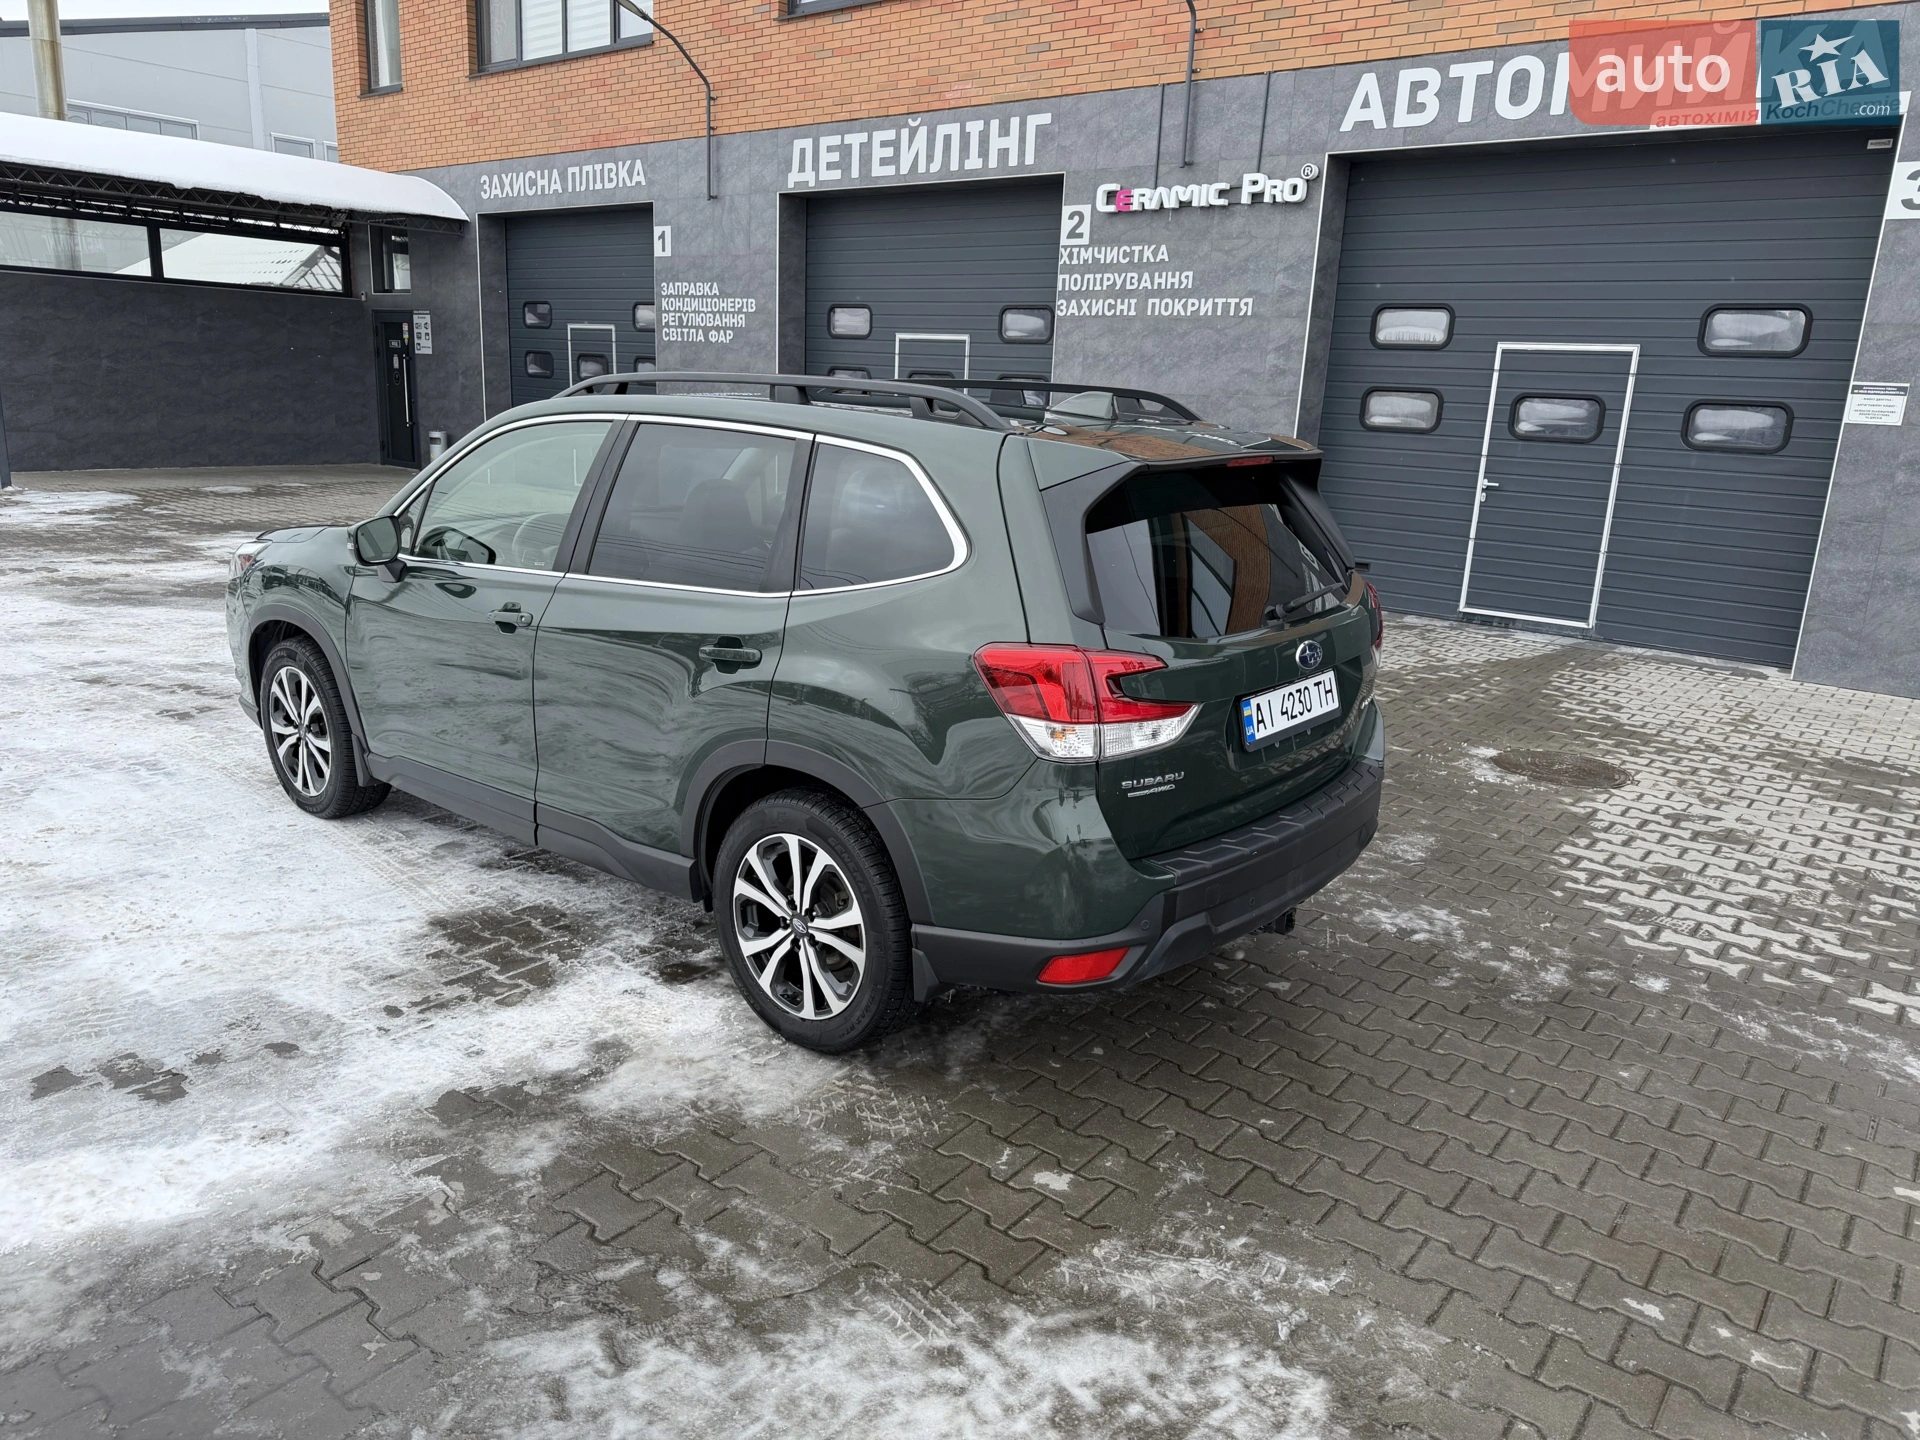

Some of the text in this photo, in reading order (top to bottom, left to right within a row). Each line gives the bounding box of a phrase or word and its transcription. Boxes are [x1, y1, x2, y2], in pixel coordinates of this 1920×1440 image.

[787, 112, 1052, 189] ДЕТЕЙЛІНГ
[480, 158, 646, 200] ЗАХИСНА ПЛІВКА
[1066, 210, 1085, 240] 2
[657, 230, 666, 253] 1
[1060, 244, 1169, 265] ХІМЧИСТКА
[661, 282, 720, 296] ЗАПРАВКА
[1058, 271, 1193, 291] ПОЛІРУВАННЯ
[661, 298, 756, 313] КОНДИЦІОНЕРІВ
[1057, 298, 1253, 317] ЗАХИСНІ ПОКРИТТЯ
[662, 312, 746, 328] РЕГУЛЮВАННЯ
[662, 328, 734, 343] СВІТЛА ФАР
[1255, 677, 1335, 733] AI 4230 TH
[1245, 725, 1255, 736] UA
[1121, 771, 1185, 789] SUBARU
